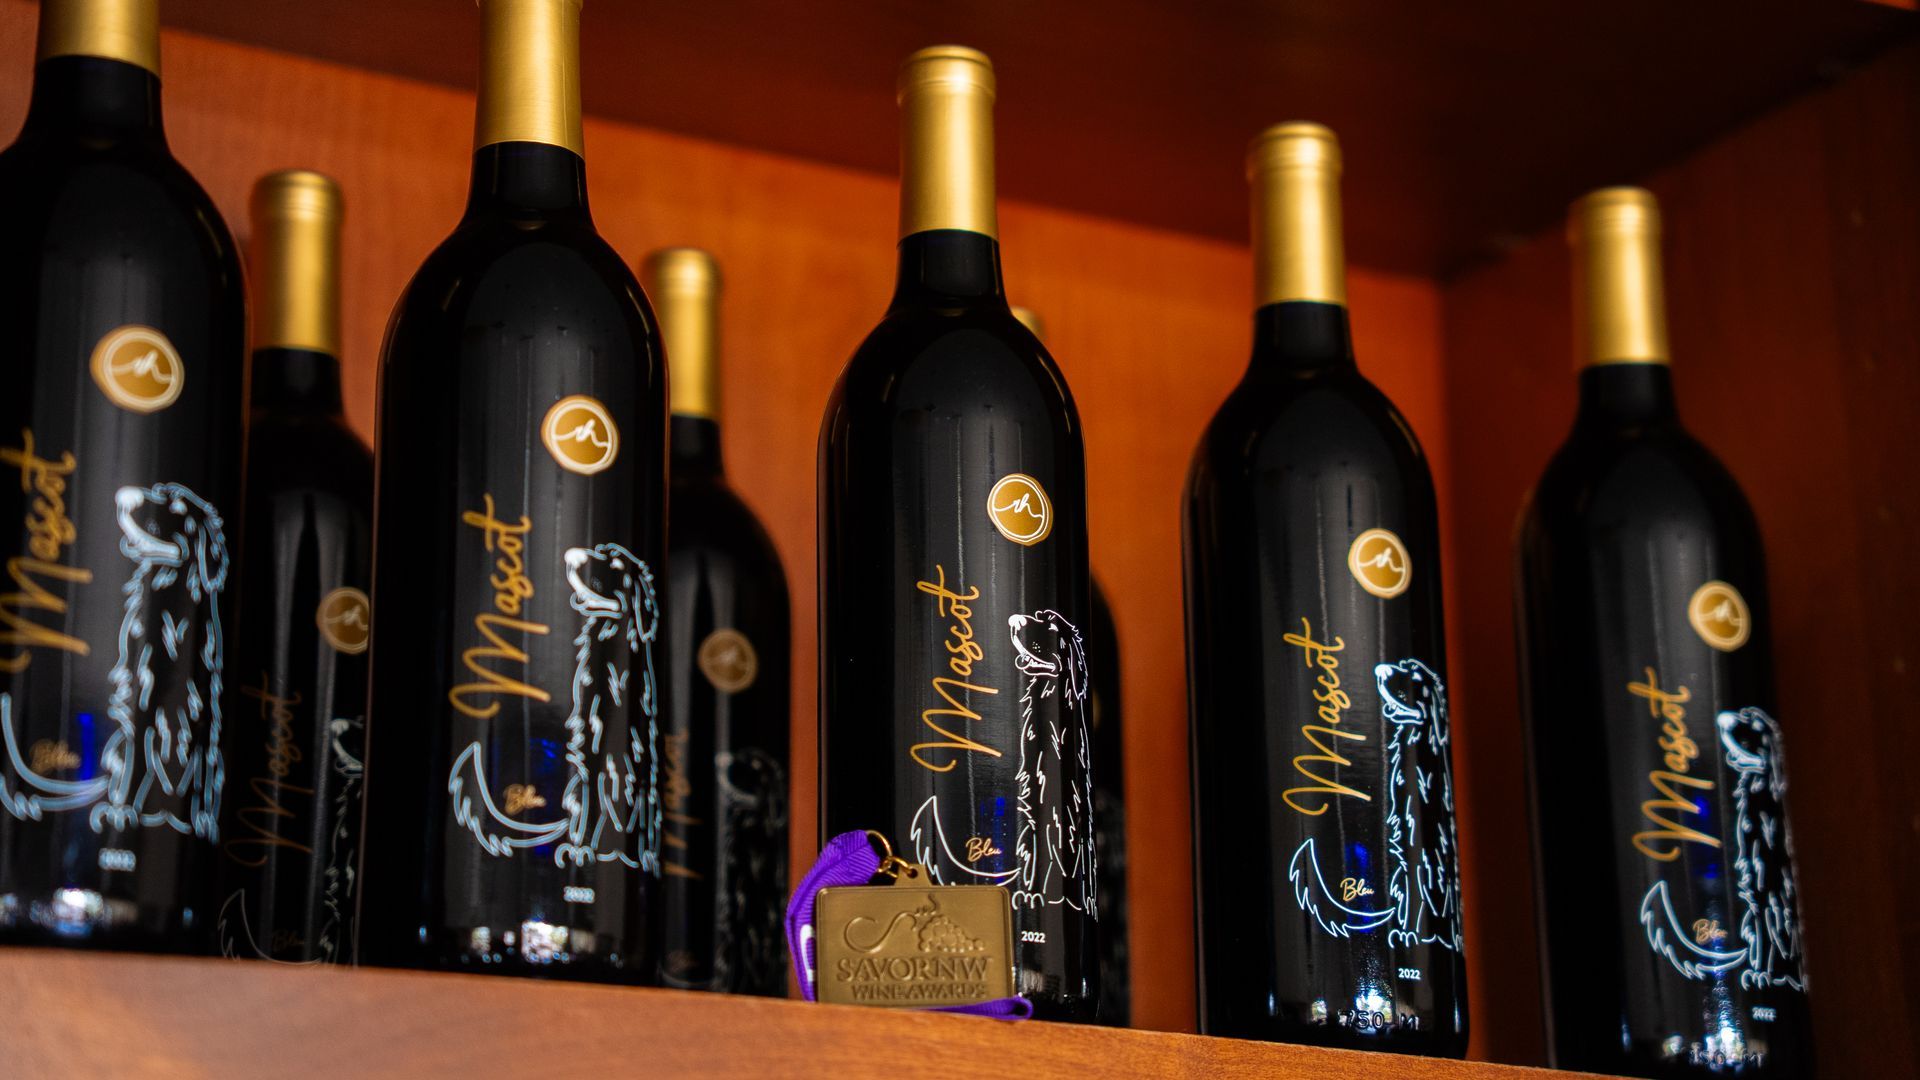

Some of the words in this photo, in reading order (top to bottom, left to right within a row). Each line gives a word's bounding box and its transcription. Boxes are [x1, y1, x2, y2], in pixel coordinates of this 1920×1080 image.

[449, 494, 551, 719] Mascot
[909, 564, 1003, 773] Mascot
[1281, 616, 1372, 817] Mascot
[1627, 666, 1721, 861] Mascot
[966, 836, 1001, 863] Bleu
[1340, 878, 1375, 902] Bleu
[1021, 930, 1046, 944] 2022
[1397, 967, 1422, 981] 2022
